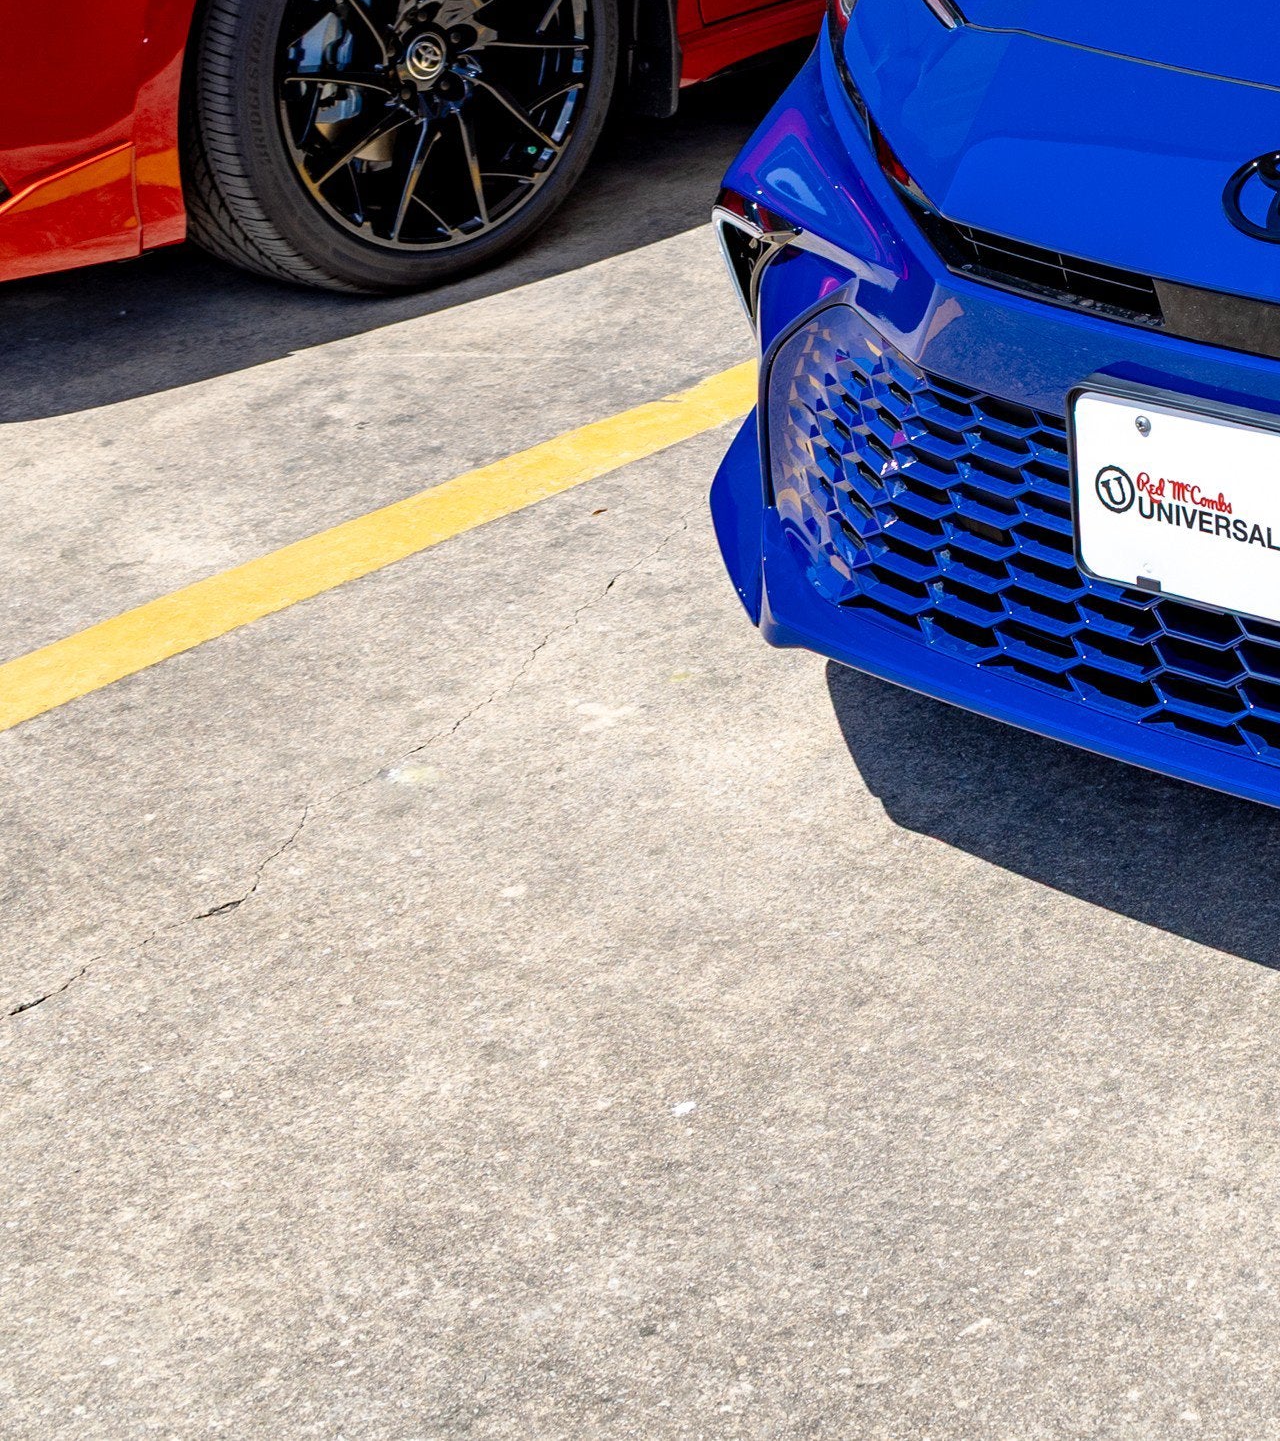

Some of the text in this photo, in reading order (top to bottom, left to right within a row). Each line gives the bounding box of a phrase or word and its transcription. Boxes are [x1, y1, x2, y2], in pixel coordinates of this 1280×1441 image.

[1136, 471, 1233, 514] Red McCombs
[1137, 498, 1280, 551] UNIVERSAL
